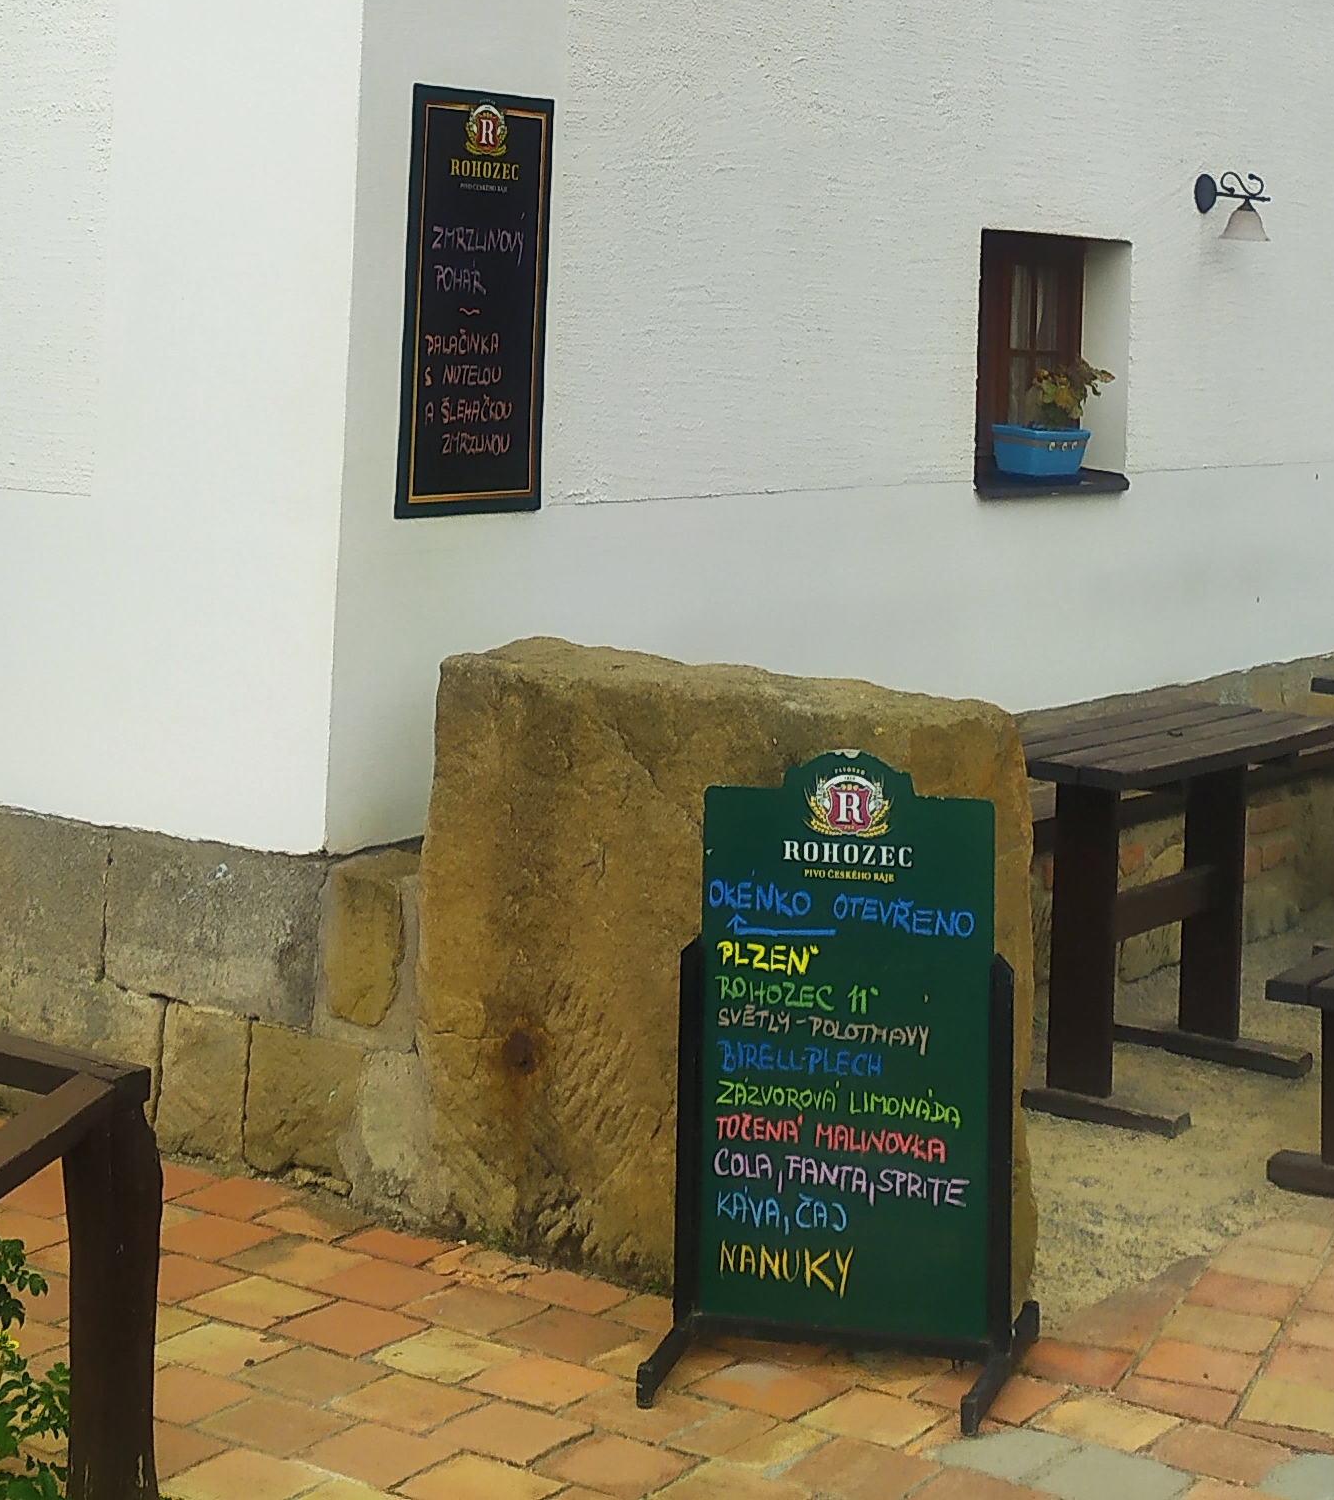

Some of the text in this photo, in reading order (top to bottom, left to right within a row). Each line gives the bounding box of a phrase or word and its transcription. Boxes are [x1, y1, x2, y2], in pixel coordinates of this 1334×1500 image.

[479, 118, 495, 146] R
[450, 158, 520, 181] ROHOZEC
[424, 366, 433, 387] S
[424, 401, 434, 426] A
[835, 791, 864, 824] R
[782, 840, 914, 868] ROHOZEC
[803, 868, 826, 879] PIVO
[832, 892, 976, 938] OTEVŘENO
[714, 974, 835, 1012] ROHOZEC
[715, 1076, 962, 1130] ZÁZVOROVÁ LIMONÁDA
[715, 1112, 948, 1165] TOČENÁ MALINOVKA
[719, 1239, 855, 1299] NANUKY
